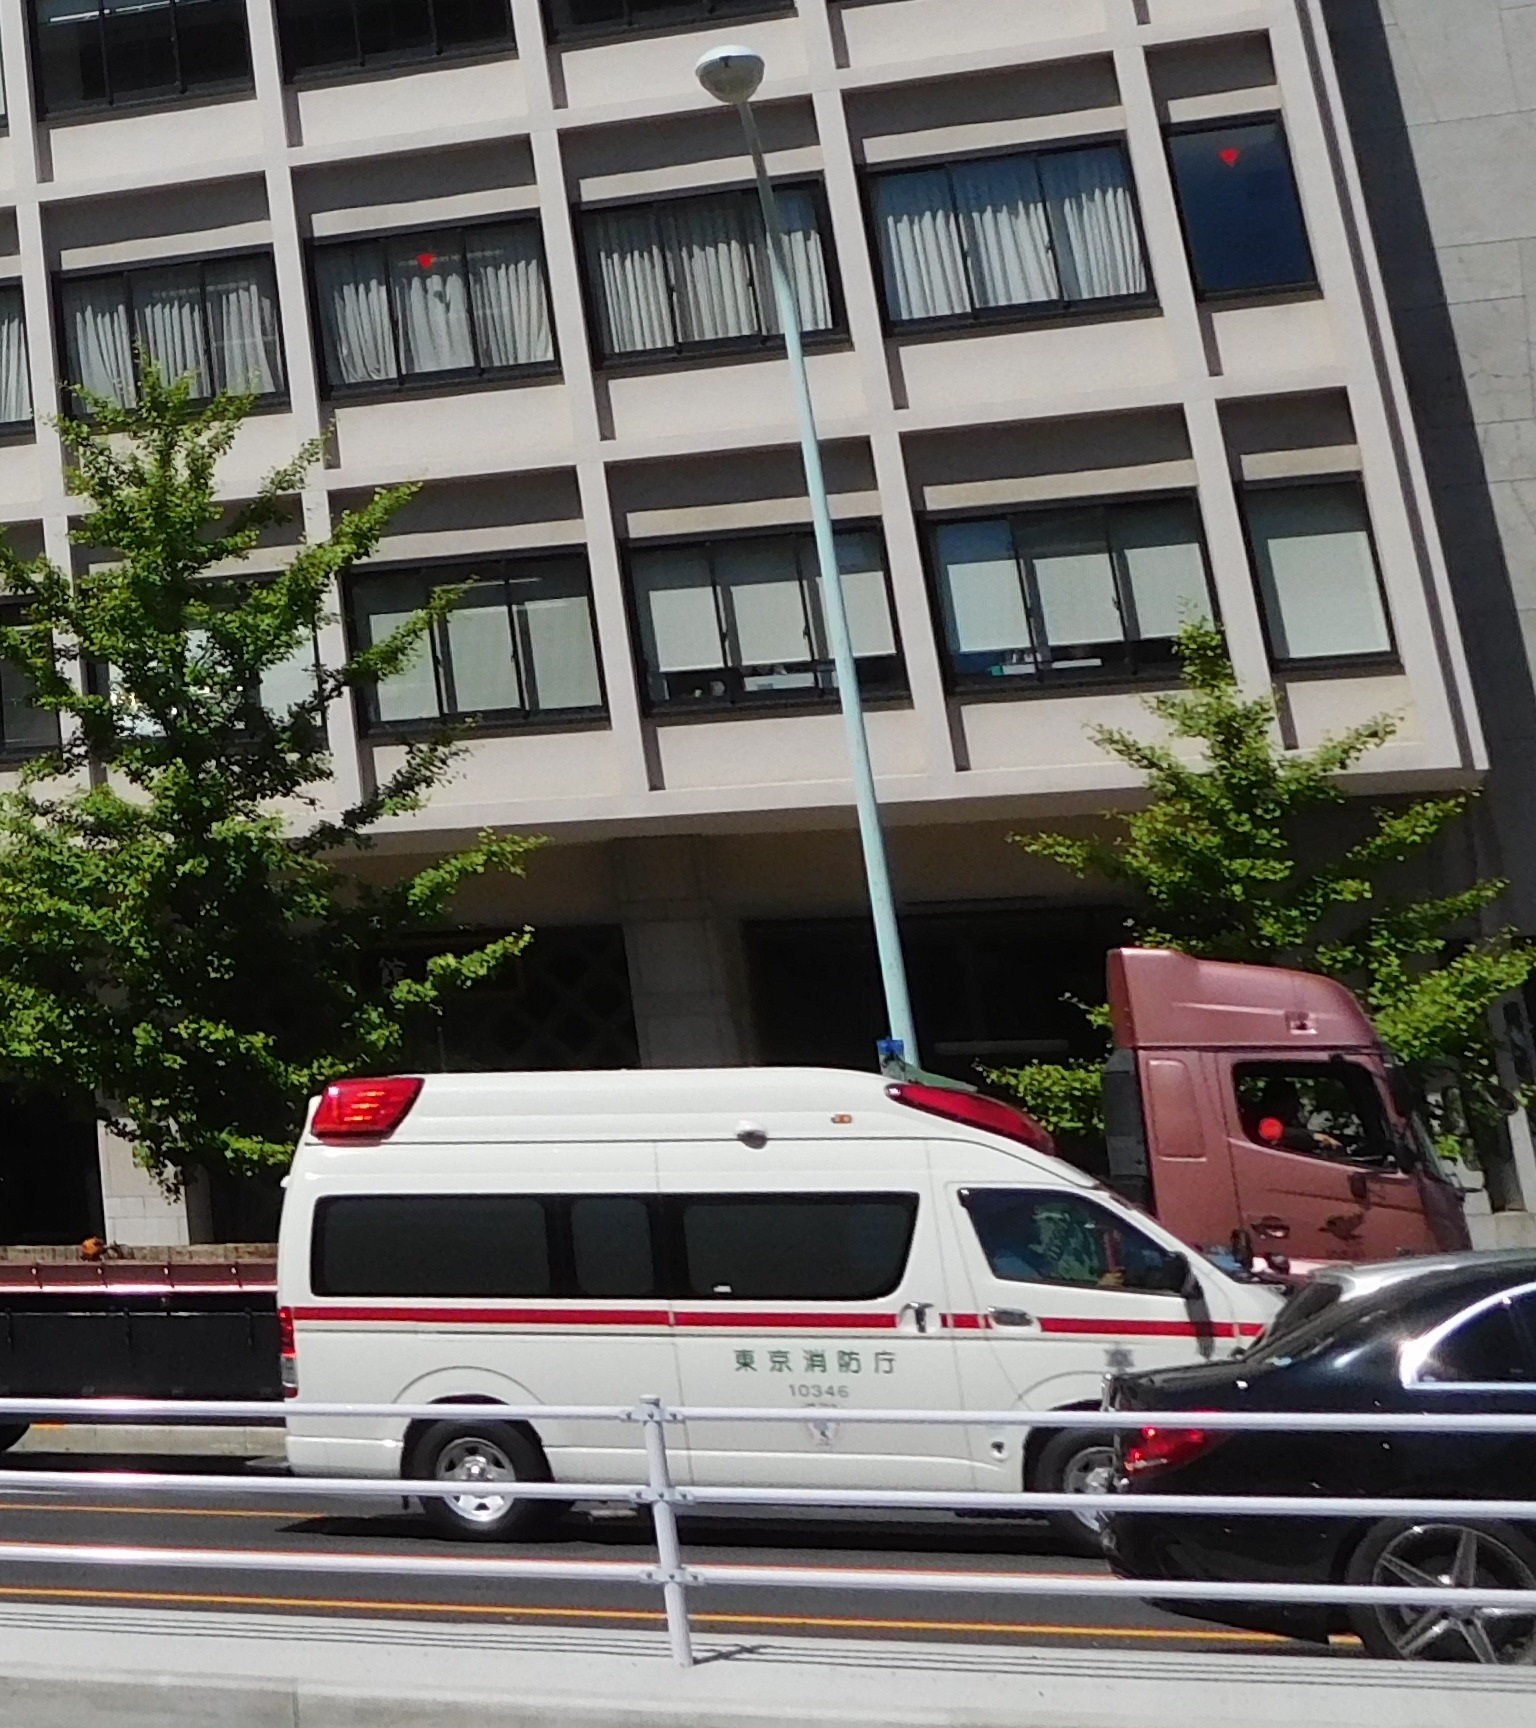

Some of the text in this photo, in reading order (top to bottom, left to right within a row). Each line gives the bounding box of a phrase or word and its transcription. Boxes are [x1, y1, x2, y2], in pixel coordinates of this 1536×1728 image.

[733, 1348, 896, 1374] 東京消防庁
[788, 1383, 850, 1398] 10346
